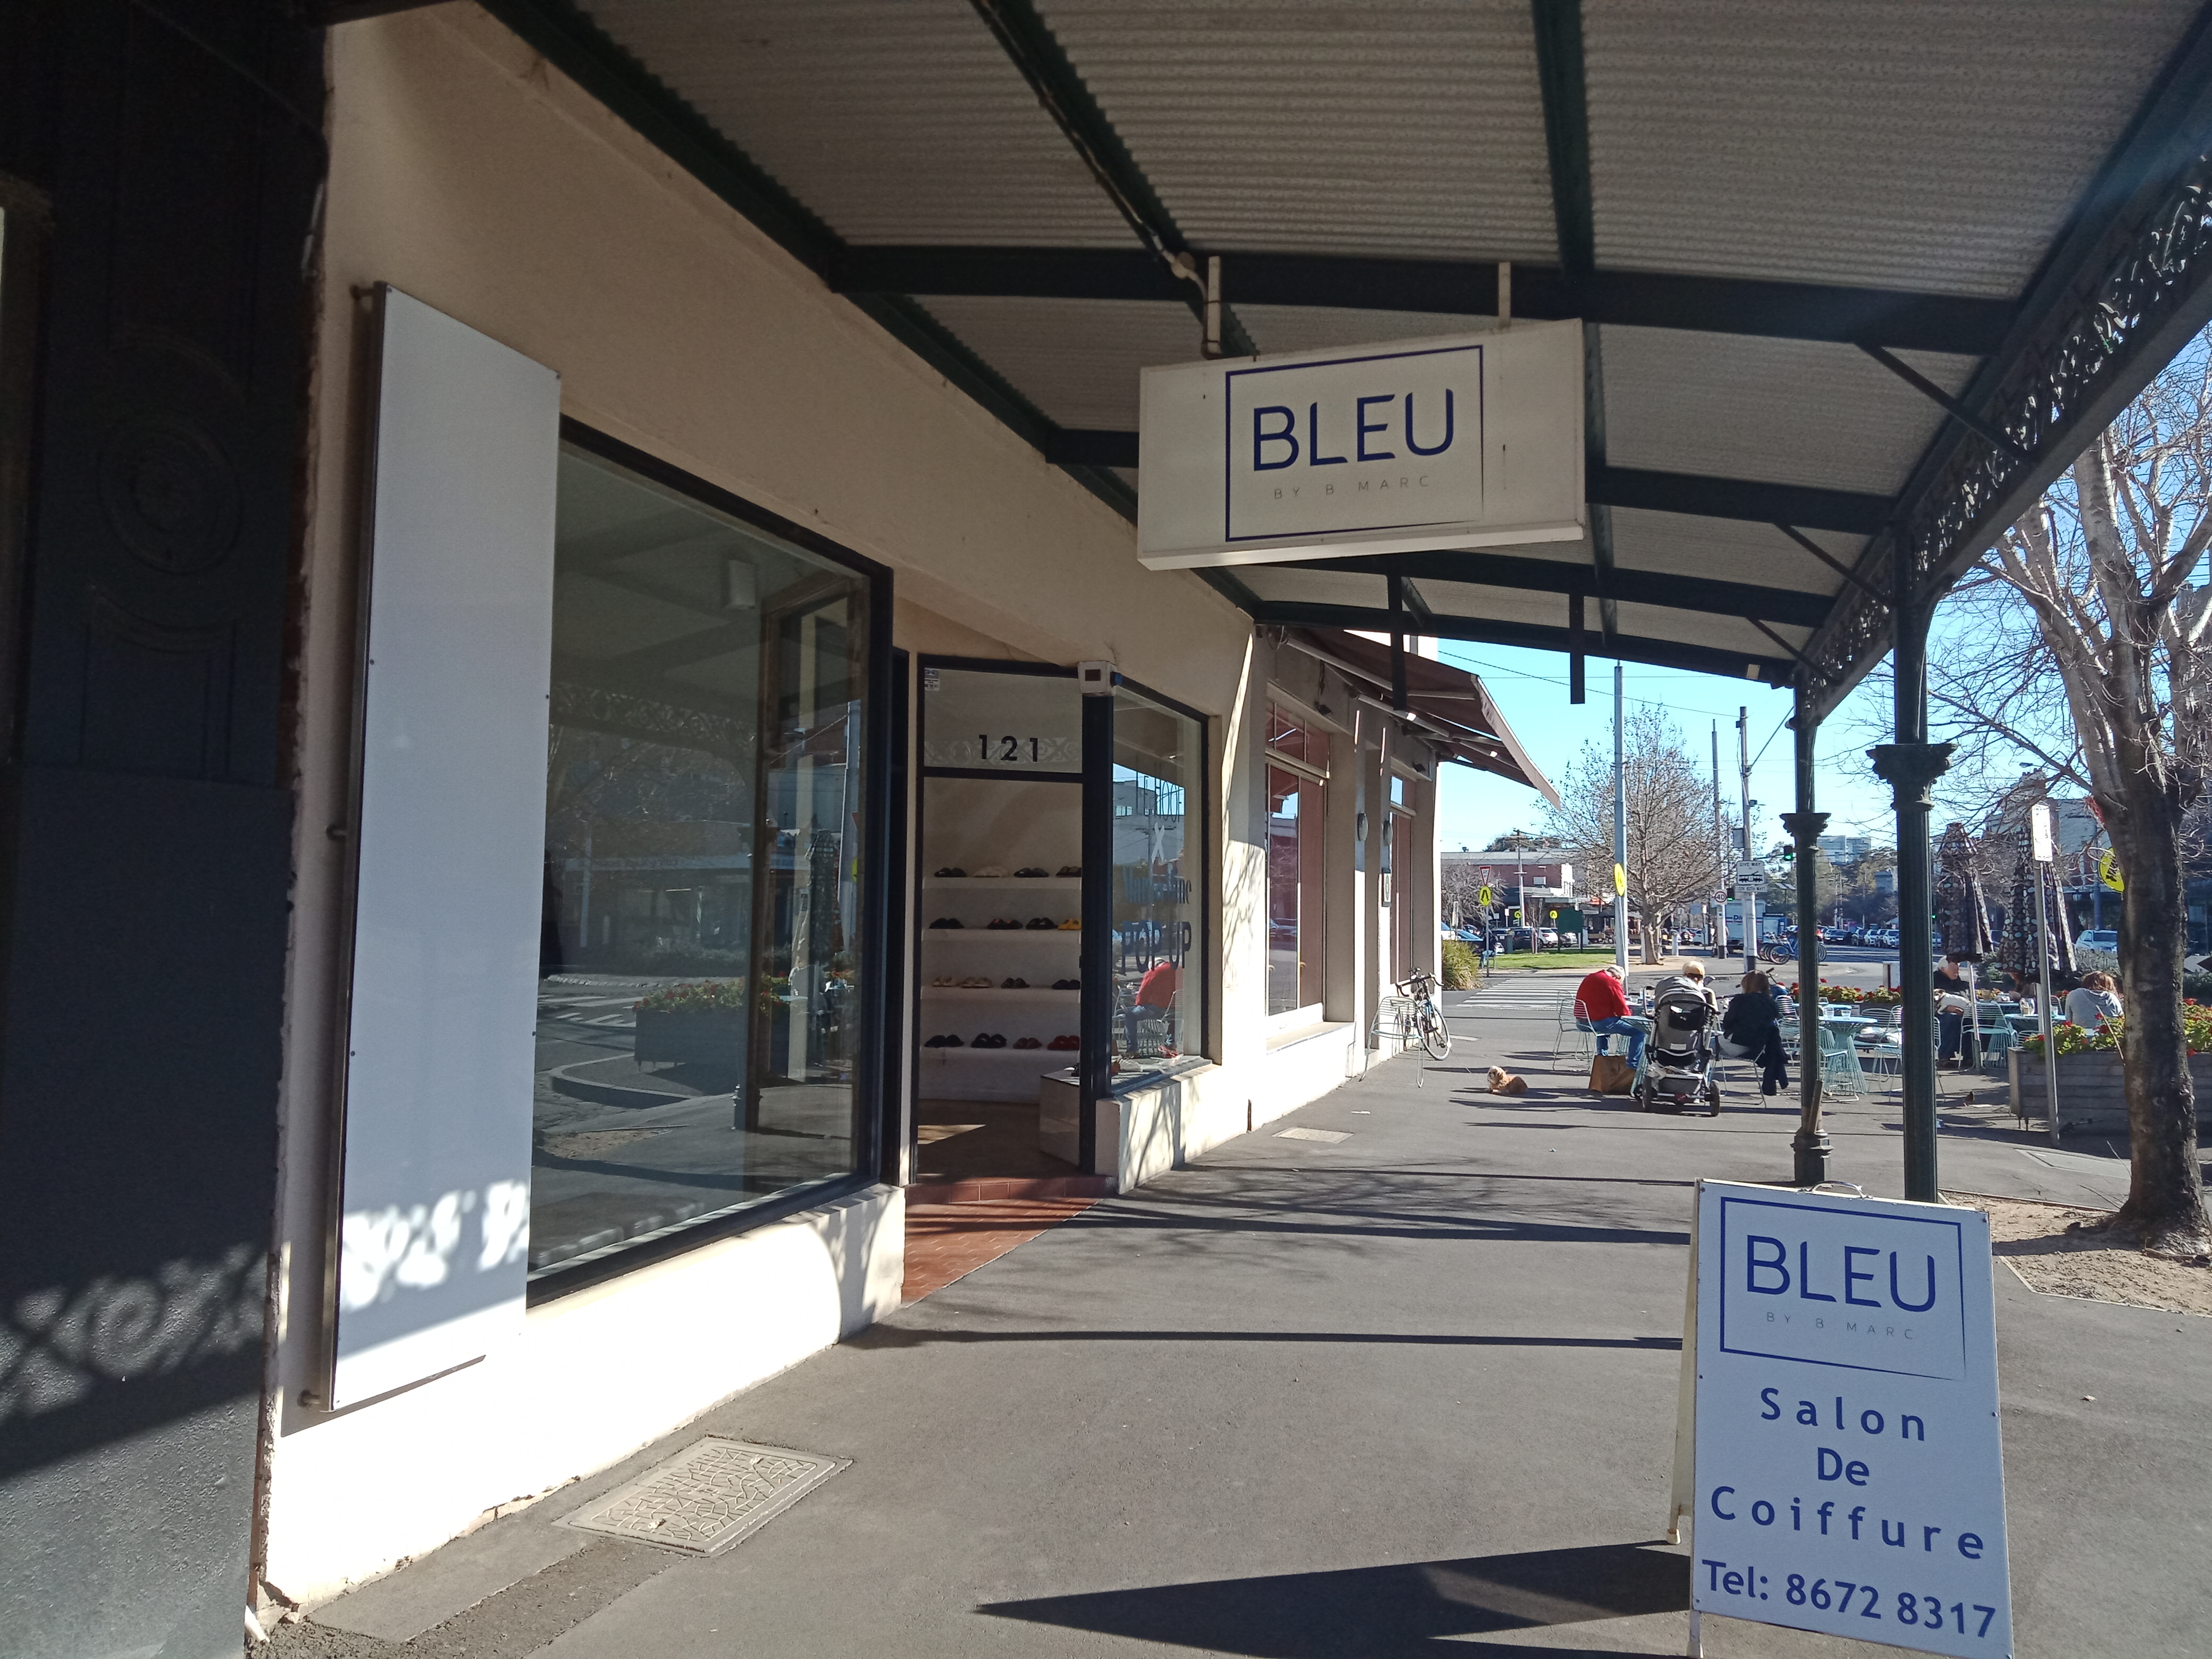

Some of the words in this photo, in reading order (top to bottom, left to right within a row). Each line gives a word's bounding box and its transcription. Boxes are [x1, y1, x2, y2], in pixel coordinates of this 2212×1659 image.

[1253, 388, 1454, 472] BLEU
[1274, 487, 1300, 499] BY
[978, 734, 1038, 763] 121
[1747, 1234, 1936, 1312] BLEU
[1767, 1312, 1791, 1323] BY
[1761, 1387, 1925, 1442] Salon
[1817, 1447, 1870, 1486] De
[1711, 1486, 1983, 1560] Coiffure
[1702, 1559, 1768, 1601] Tel:
[1786, 1573, 1881, 1620] 8672
[1897, 1592, 1996, 1638] 8317
